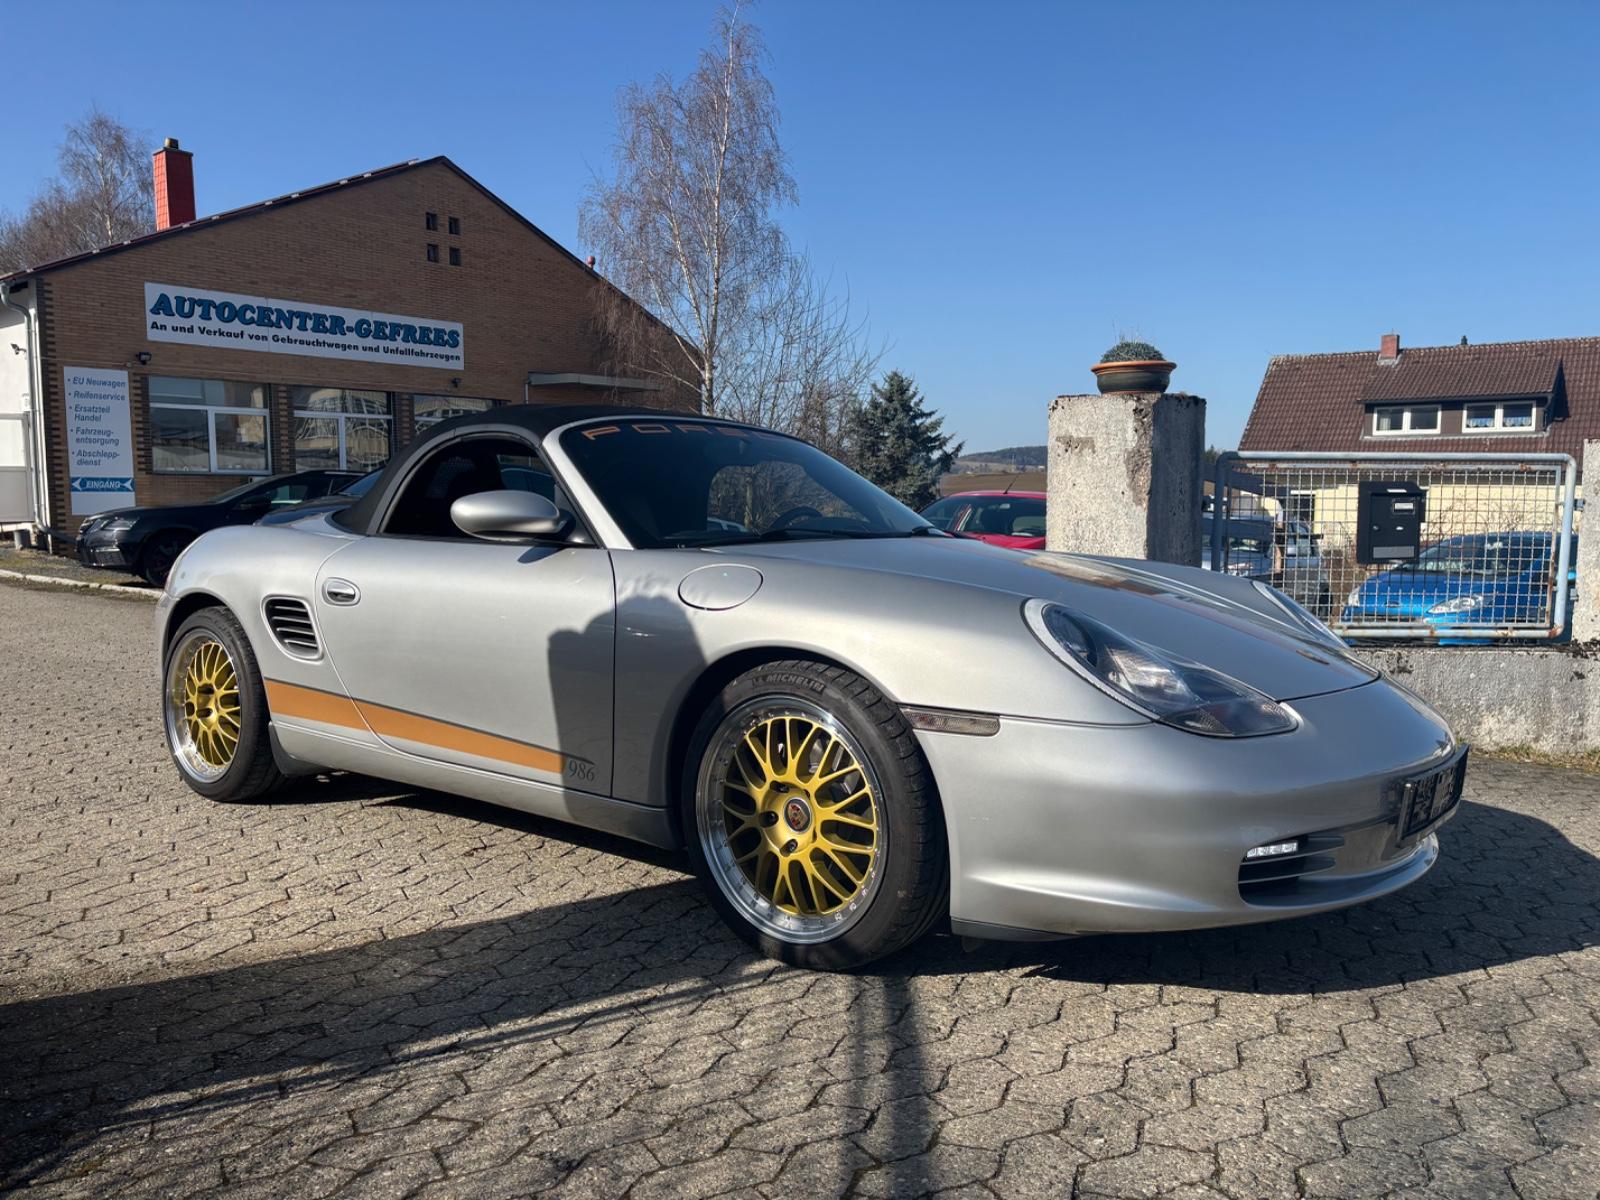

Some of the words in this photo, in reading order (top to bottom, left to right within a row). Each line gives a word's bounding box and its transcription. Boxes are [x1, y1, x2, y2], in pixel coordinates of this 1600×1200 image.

[150, 293, 459, 348] AUTOCENTER-GEFREES
[151, 321, 167, 331] An
[171, 324, 194, 334] und
[198, 326, 244, 340] Verkauf
[248, 333, 268, 342] von
[272, 334, 359, 352] Gebrauchtwagen
[362, 344, 380, 353] und
[383, 346, 460, 362] Unfallfahrzeugen
[73, 376, 84, 385] EU
[86, 377, 126, 389] Neuwagen
[74, 391, 126, 401] Reifenservice
[74, 404, 110, 414] Ersatzteil
[75, 414, 102, 422] Handel
[76, 436, 120, 446] entsorgung
[77, 458, 101, 466] dienst
[766, 673, 825, 692] MICHELIN
[568, 759, 595, 781] 986
